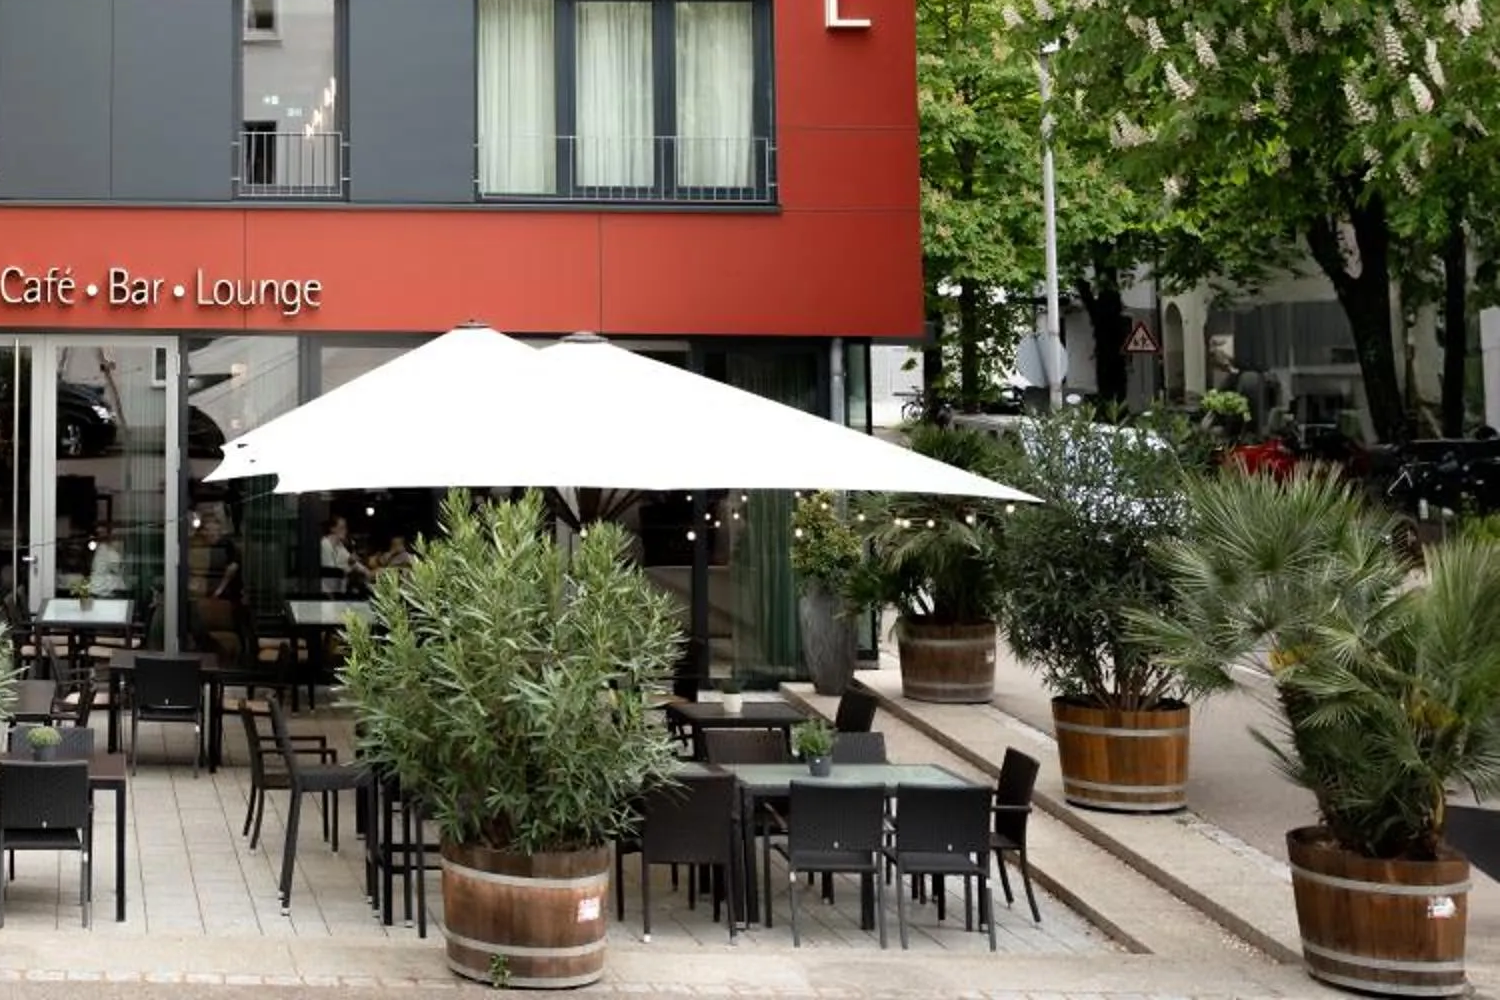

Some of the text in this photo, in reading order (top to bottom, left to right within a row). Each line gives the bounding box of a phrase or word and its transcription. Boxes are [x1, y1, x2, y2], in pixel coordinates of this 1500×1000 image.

[0, 266, 323, 315] Café Bar Lounge
